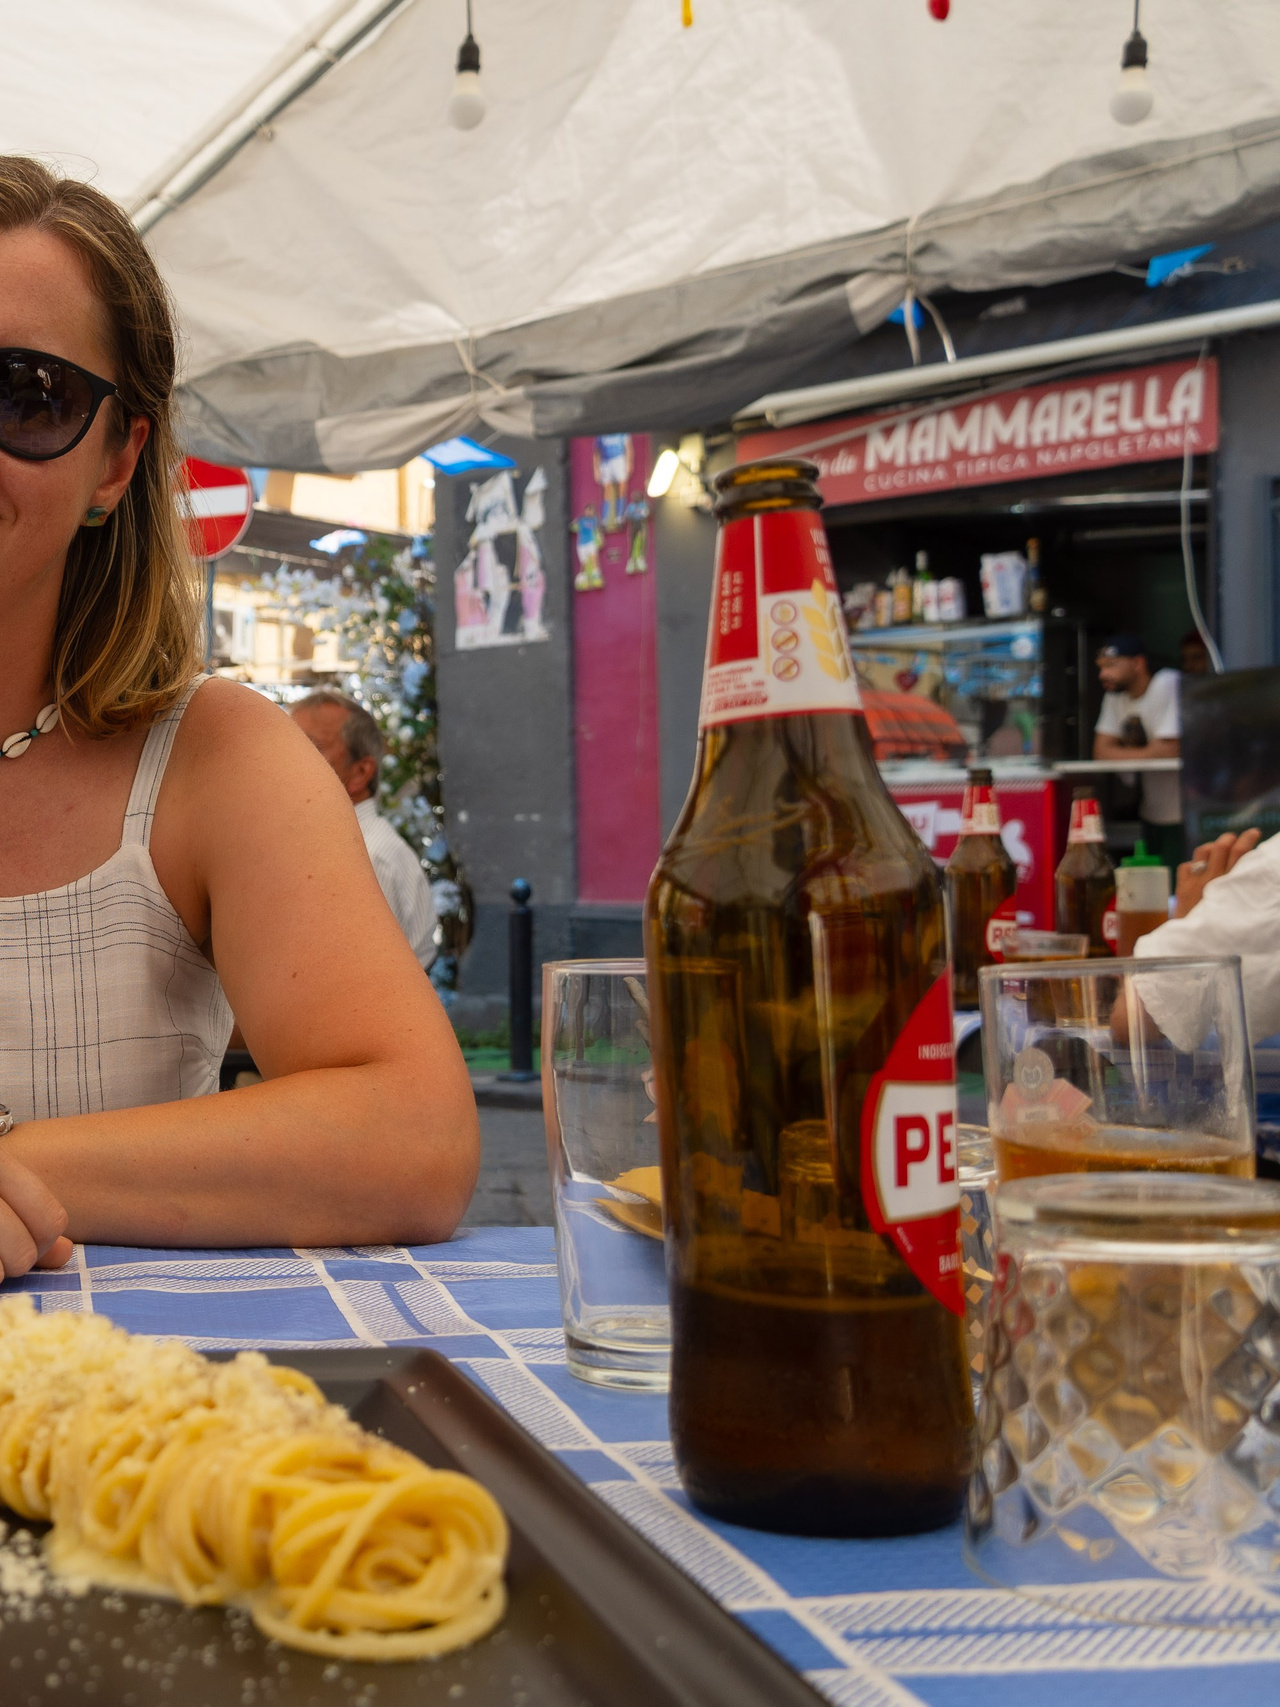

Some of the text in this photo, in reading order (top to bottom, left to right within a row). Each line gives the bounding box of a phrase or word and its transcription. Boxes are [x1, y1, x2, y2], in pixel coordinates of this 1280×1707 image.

[863, 464, 948, 493] CUCINA
[954, 452, 1030, 479] TIPICA
[1036, 426, 1201, 467] NAPOLETANA
[864, 367, 1206, 472] MAMMARELLA
